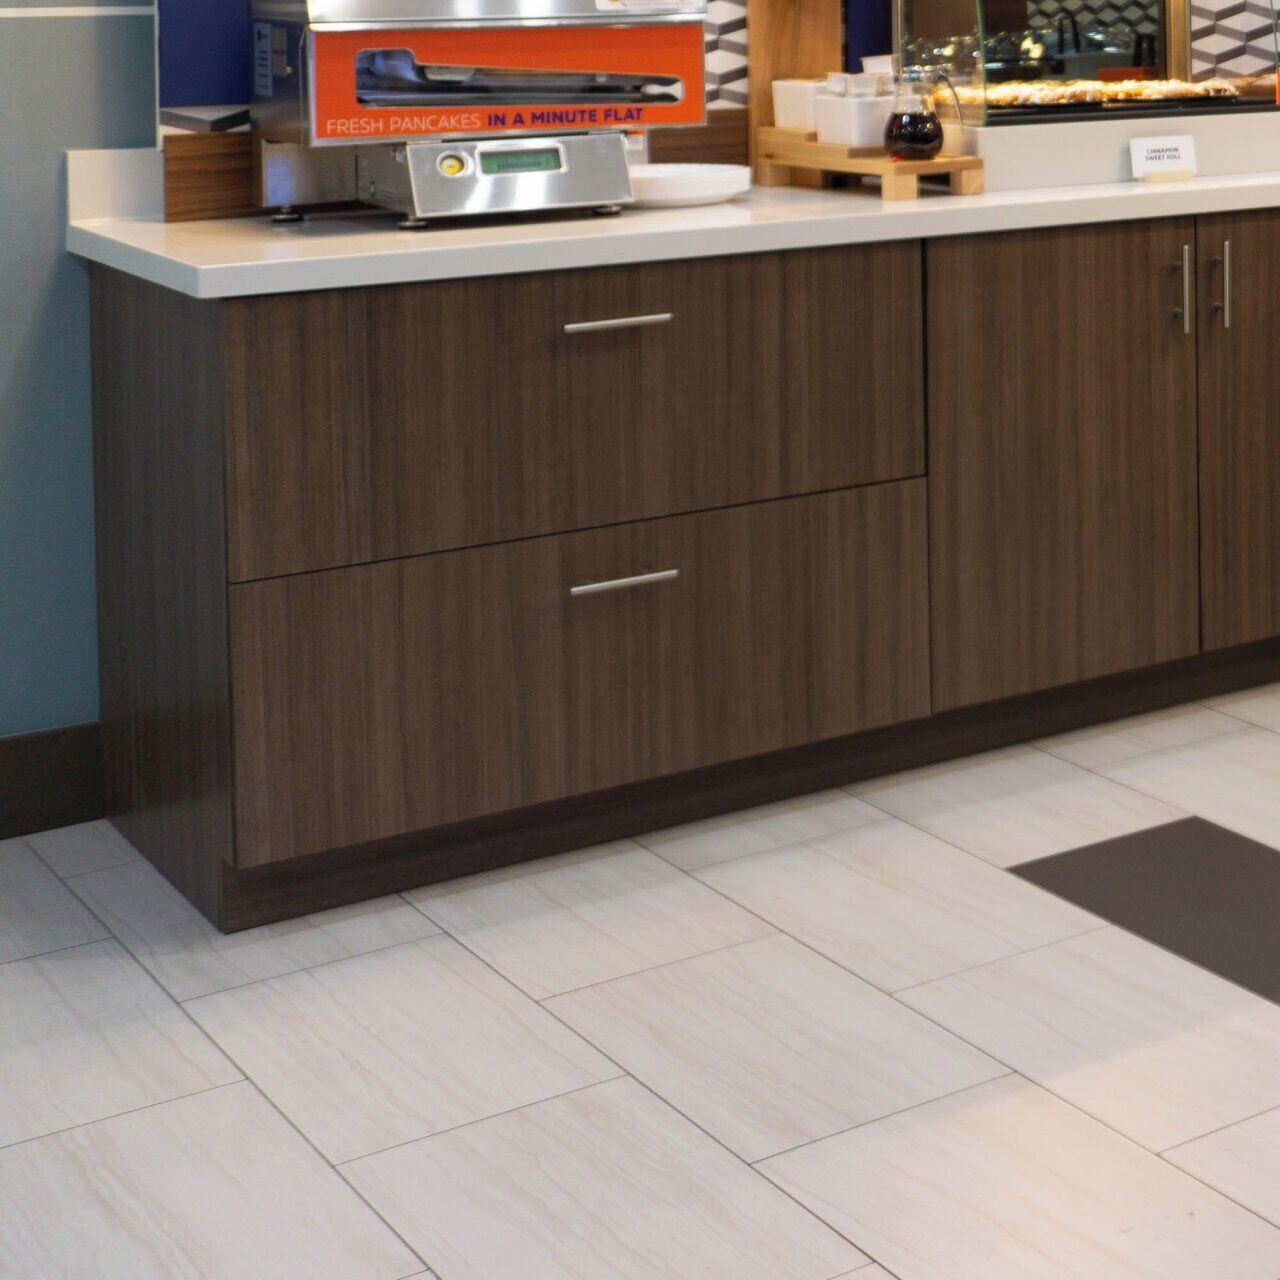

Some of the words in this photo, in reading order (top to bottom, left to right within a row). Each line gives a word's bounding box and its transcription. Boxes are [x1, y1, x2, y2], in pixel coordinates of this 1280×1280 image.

[326, 118, 384, 135] FRESH
[390, 113, 481, 132] PANCAKES
[487, 112, 507, 127] IN
[512, 112, 524, 125] A
[531, 108, 598, 125] MINUTE
[604, 107, 644, 122] FLAT
[1146, 147, 1179, 155] CINNAMON
